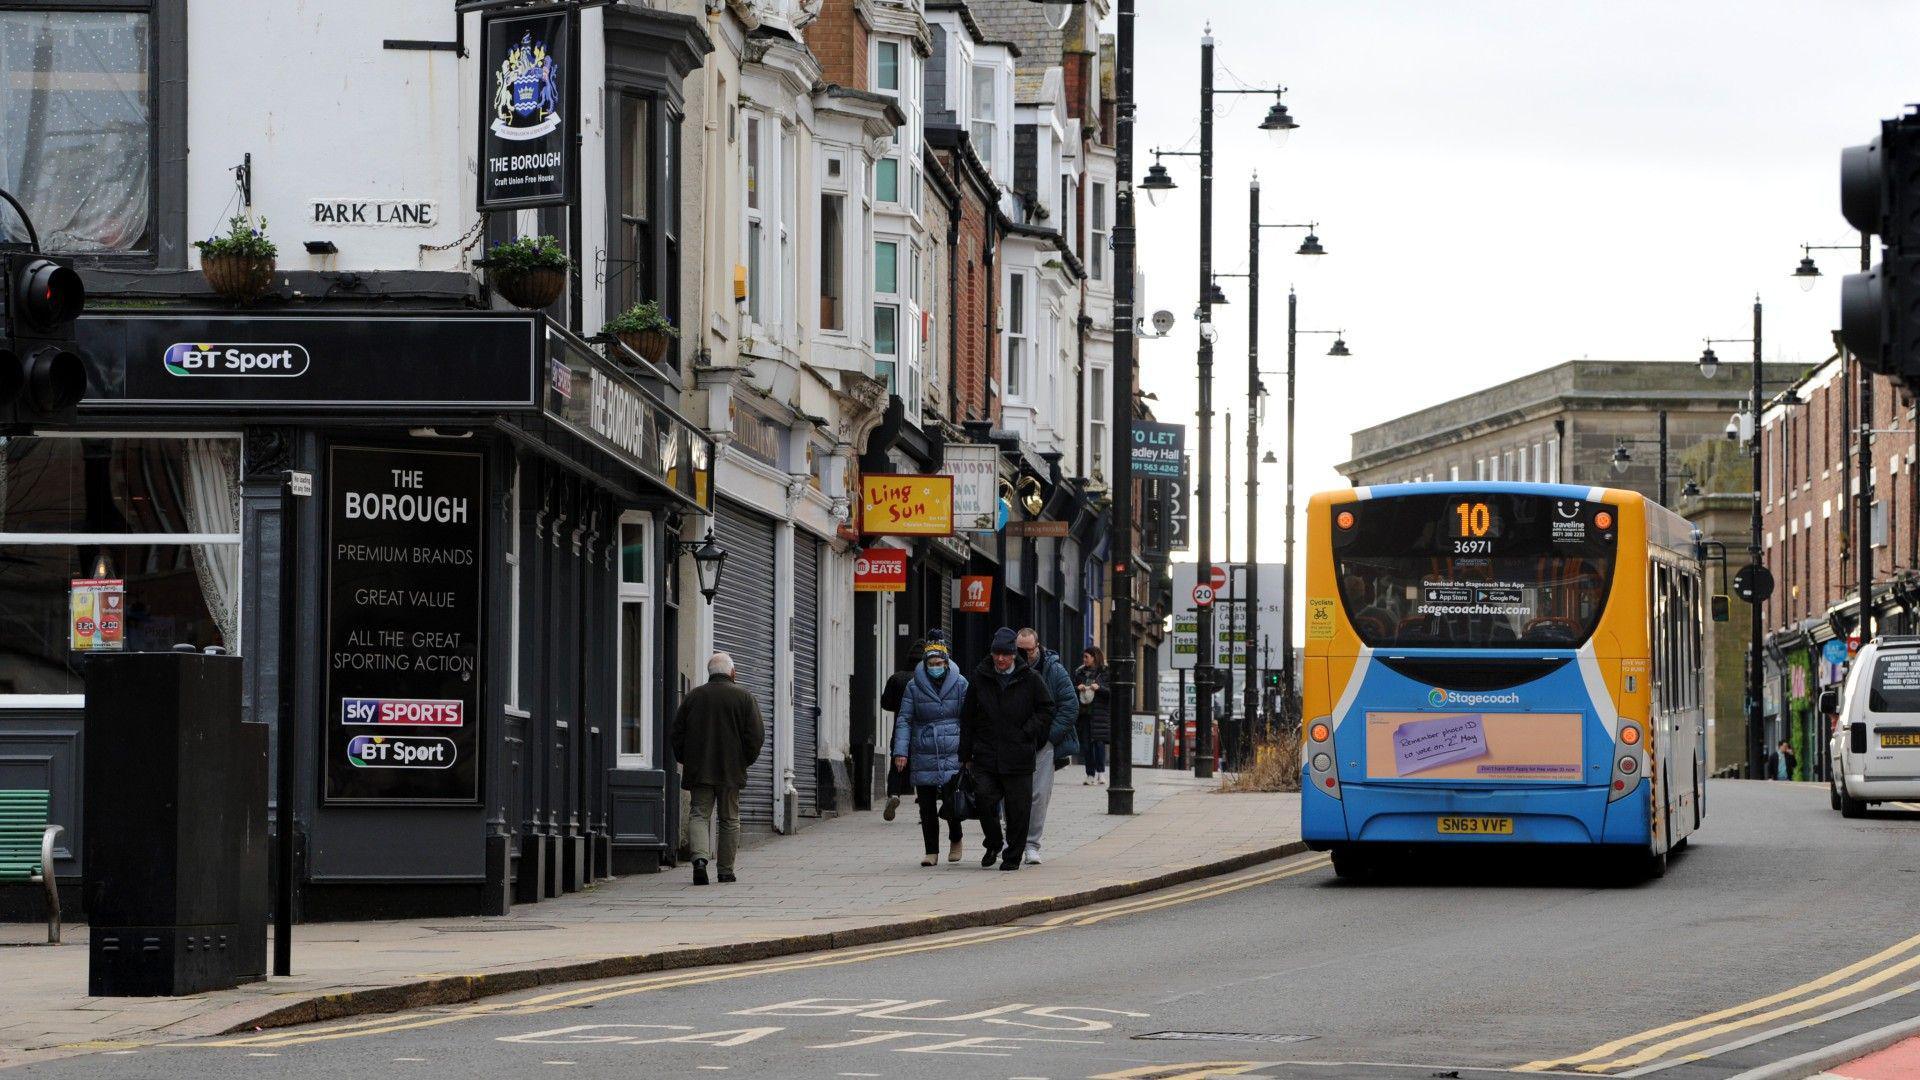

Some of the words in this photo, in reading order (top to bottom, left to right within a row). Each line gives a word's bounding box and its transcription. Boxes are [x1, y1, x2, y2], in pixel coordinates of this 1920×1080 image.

[490, 157, 508, 172] THE
[511, 152, 561, 171] BOROUGH
[495, 178, 507, 186] Craft
[538, 174, 554, 182] House
[315, 203, 367, 222] PARK
[376, 203, 431, 223] LANE
[182, 351, 221, 368] BT
[225, 349, 292, 373] Sport
[590, 367, 607, 436] THE
[606, 380, 644, 459] BOROUGH
[1149, 431, 1175, 445] LET
[1132, 447, 1158, 462] adley
[1160, 448, 1179, 460] Hall
[391, 469, 423, 489] THE
[870, 484, 913, 505] Ling
[345, 492, 467, 524] BOROUGH
[888, 503, 925, 523] Sun
[1456, 503, 1490, 537] 10
[338, 544, 408, 563] PREMIUM
[413, 547, 473, 565] BRANDS
[1453, 541, 1492, 553] 36971
[871, 565, 902, 574] EATS
[355, 589, 404, 606] GREAT
[409, 591, 455, 608] VALUE
[1196, 589, 1212, 599] 20
[1417, 604, 1531, 617] stagecoachbus.com
[348, 630, 374, 646] ALL
[378, 631, 404, 647] THE
[412, 632, 461, 648] GREAT
[334, 653, 410, 670] SPORTING
[414, 655, 474, 672] ACTION
[1448, 692, 1520, 706] Stagecoach
[347, 700, 376, 723] sky
[381, 703, 458, 722] SPORTS
[1400, 733, 1439, 747] Remember
[1442, 725, 1464, 737] photo
[1464, 721, 1476, 729] ID
[361, 743, 391, 760] BT
[393, 741, 444, 764] Sport
[1416, 746, 1431, 755] vote
[1461, 735, 1477, 743] May
[1443, 818, 1478, 831] SN63
[1481, 819, 1507, 831] VVF
[722, 998, 1150, 1031] BUS
[495, 1024, 1104, 1056] GATE
